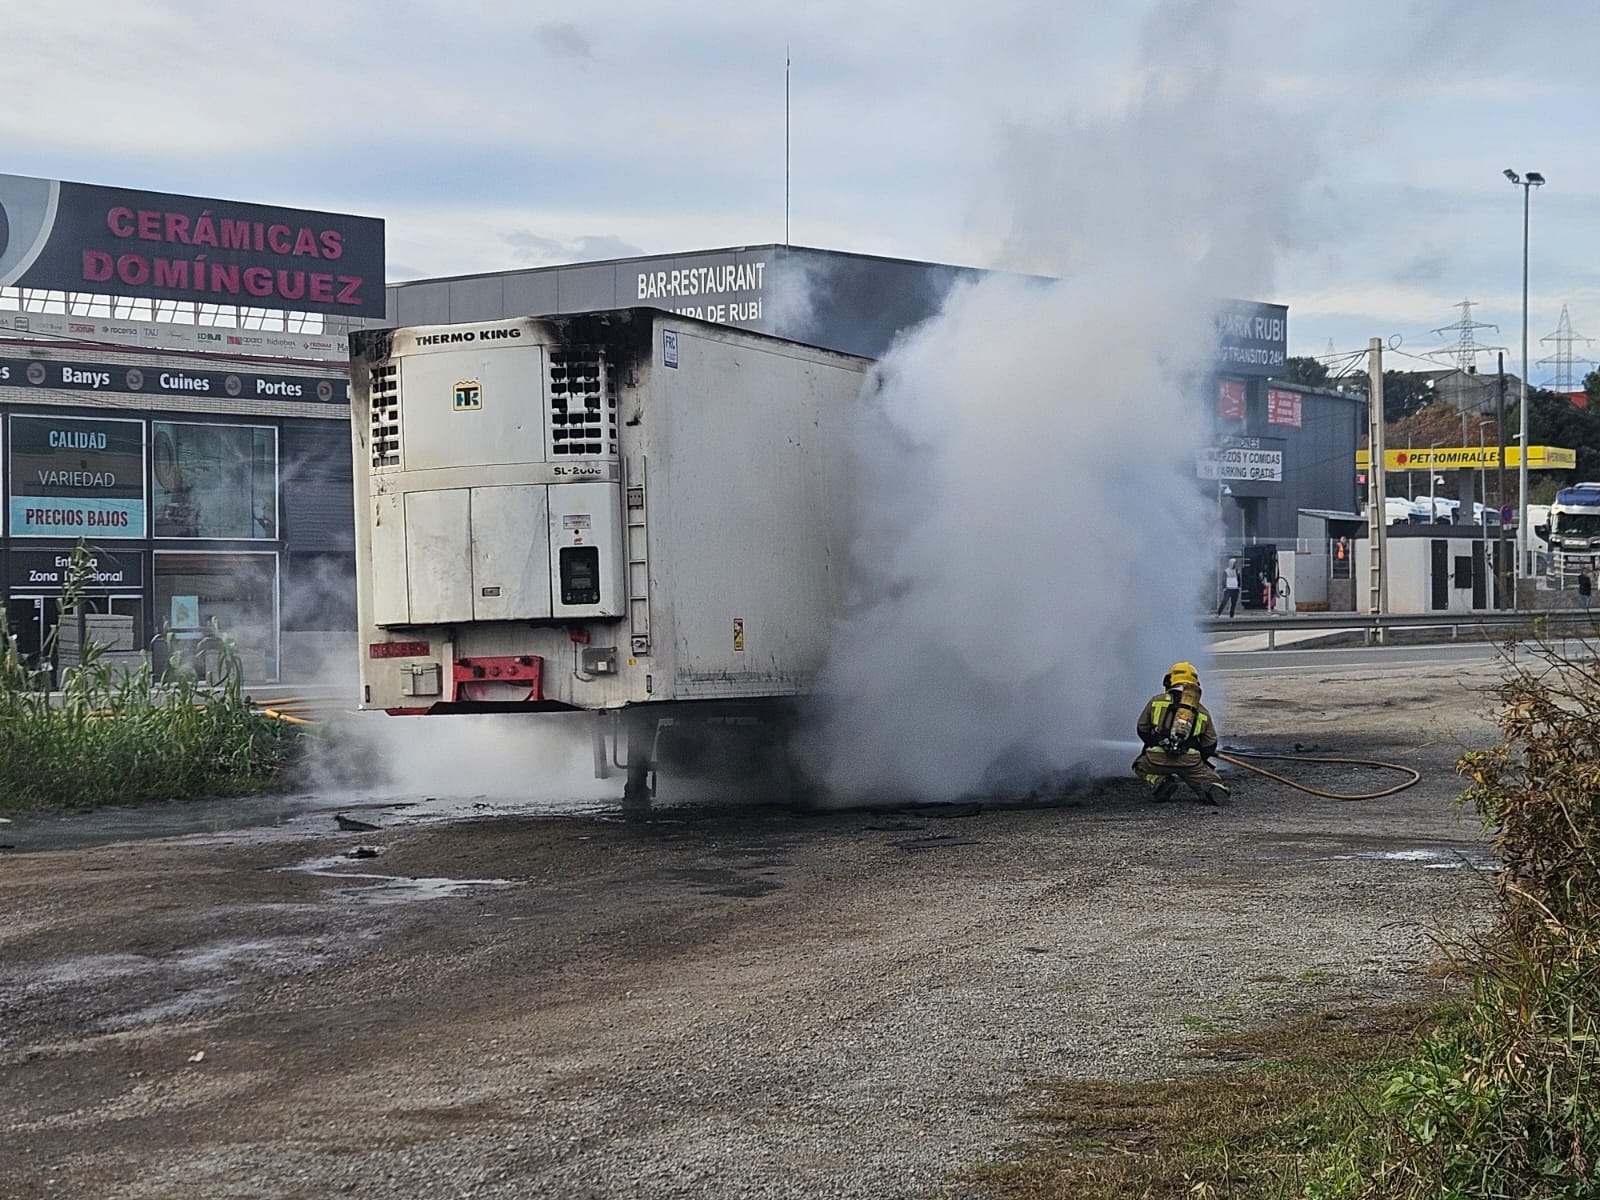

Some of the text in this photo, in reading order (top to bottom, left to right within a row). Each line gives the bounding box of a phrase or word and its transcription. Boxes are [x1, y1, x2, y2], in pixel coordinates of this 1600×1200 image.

[107, 206, 344, 260] CERÁMICAS
[82, 249, 363, 305] DOMÍNGUEZ
[637, 262, 766, 300] BAR-RESTAURANT
[707, 304, 726, 323] DE
[729, 296, 762, 322] RUBÍ
[415, 328, 521, 346] THERMO KING
[1255, 316, 1284, 342] RUBI
[665, 335, 676, 350] FRC
[62, 367, 110, 389] Banys
[160, 373, 210, 391] Cuines
[256, 379, 302, 396] Portes
[49, 430, 107, 450] CALIDAD
[1248, 453, 1281, 465] COMIDAS
[38, 470, 116, 488] VARIEDAD
[1249, 466, 1275, 479] GRATIS
[25, 508, 129, 527] PRECIOS BAJOS
[29, 570, 58, 582] Zona
